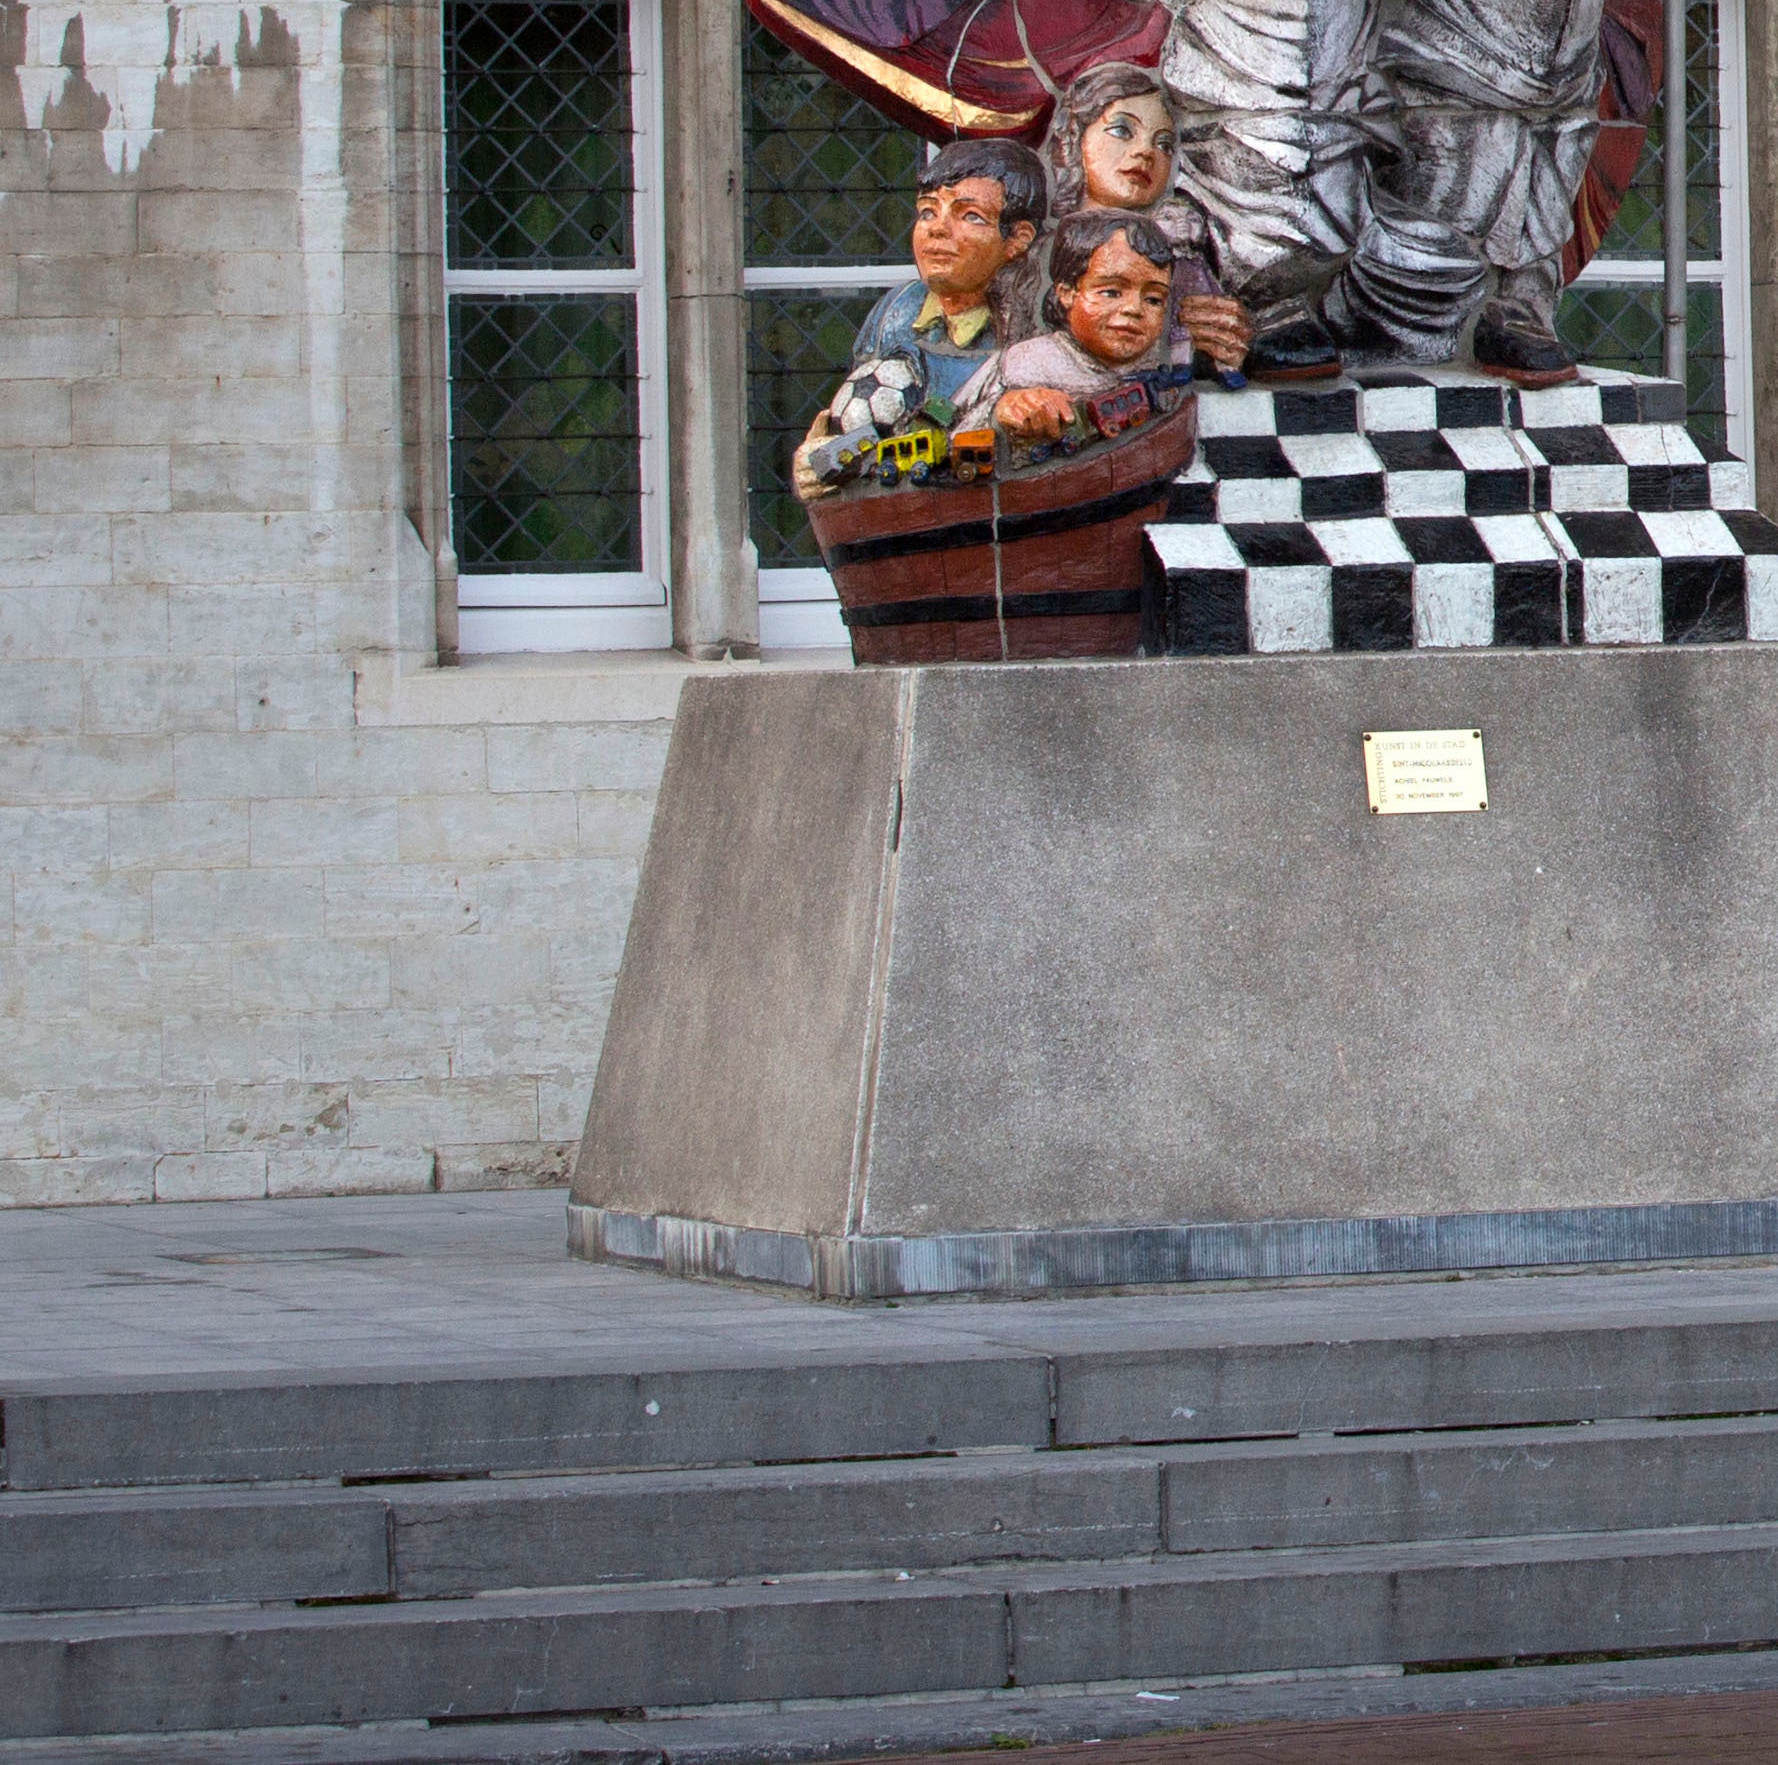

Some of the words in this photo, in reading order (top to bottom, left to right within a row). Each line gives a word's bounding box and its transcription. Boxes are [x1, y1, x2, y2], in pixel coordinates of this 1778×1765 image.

[1375, 742, 1405, 750] KUNST
[1410, 741, 1421, 749] IN
[1426, 741, 1439, 749] DE
[1442, 740, 1466, 749] STAD
[1375, 752, 1388, 804] STICHTING
